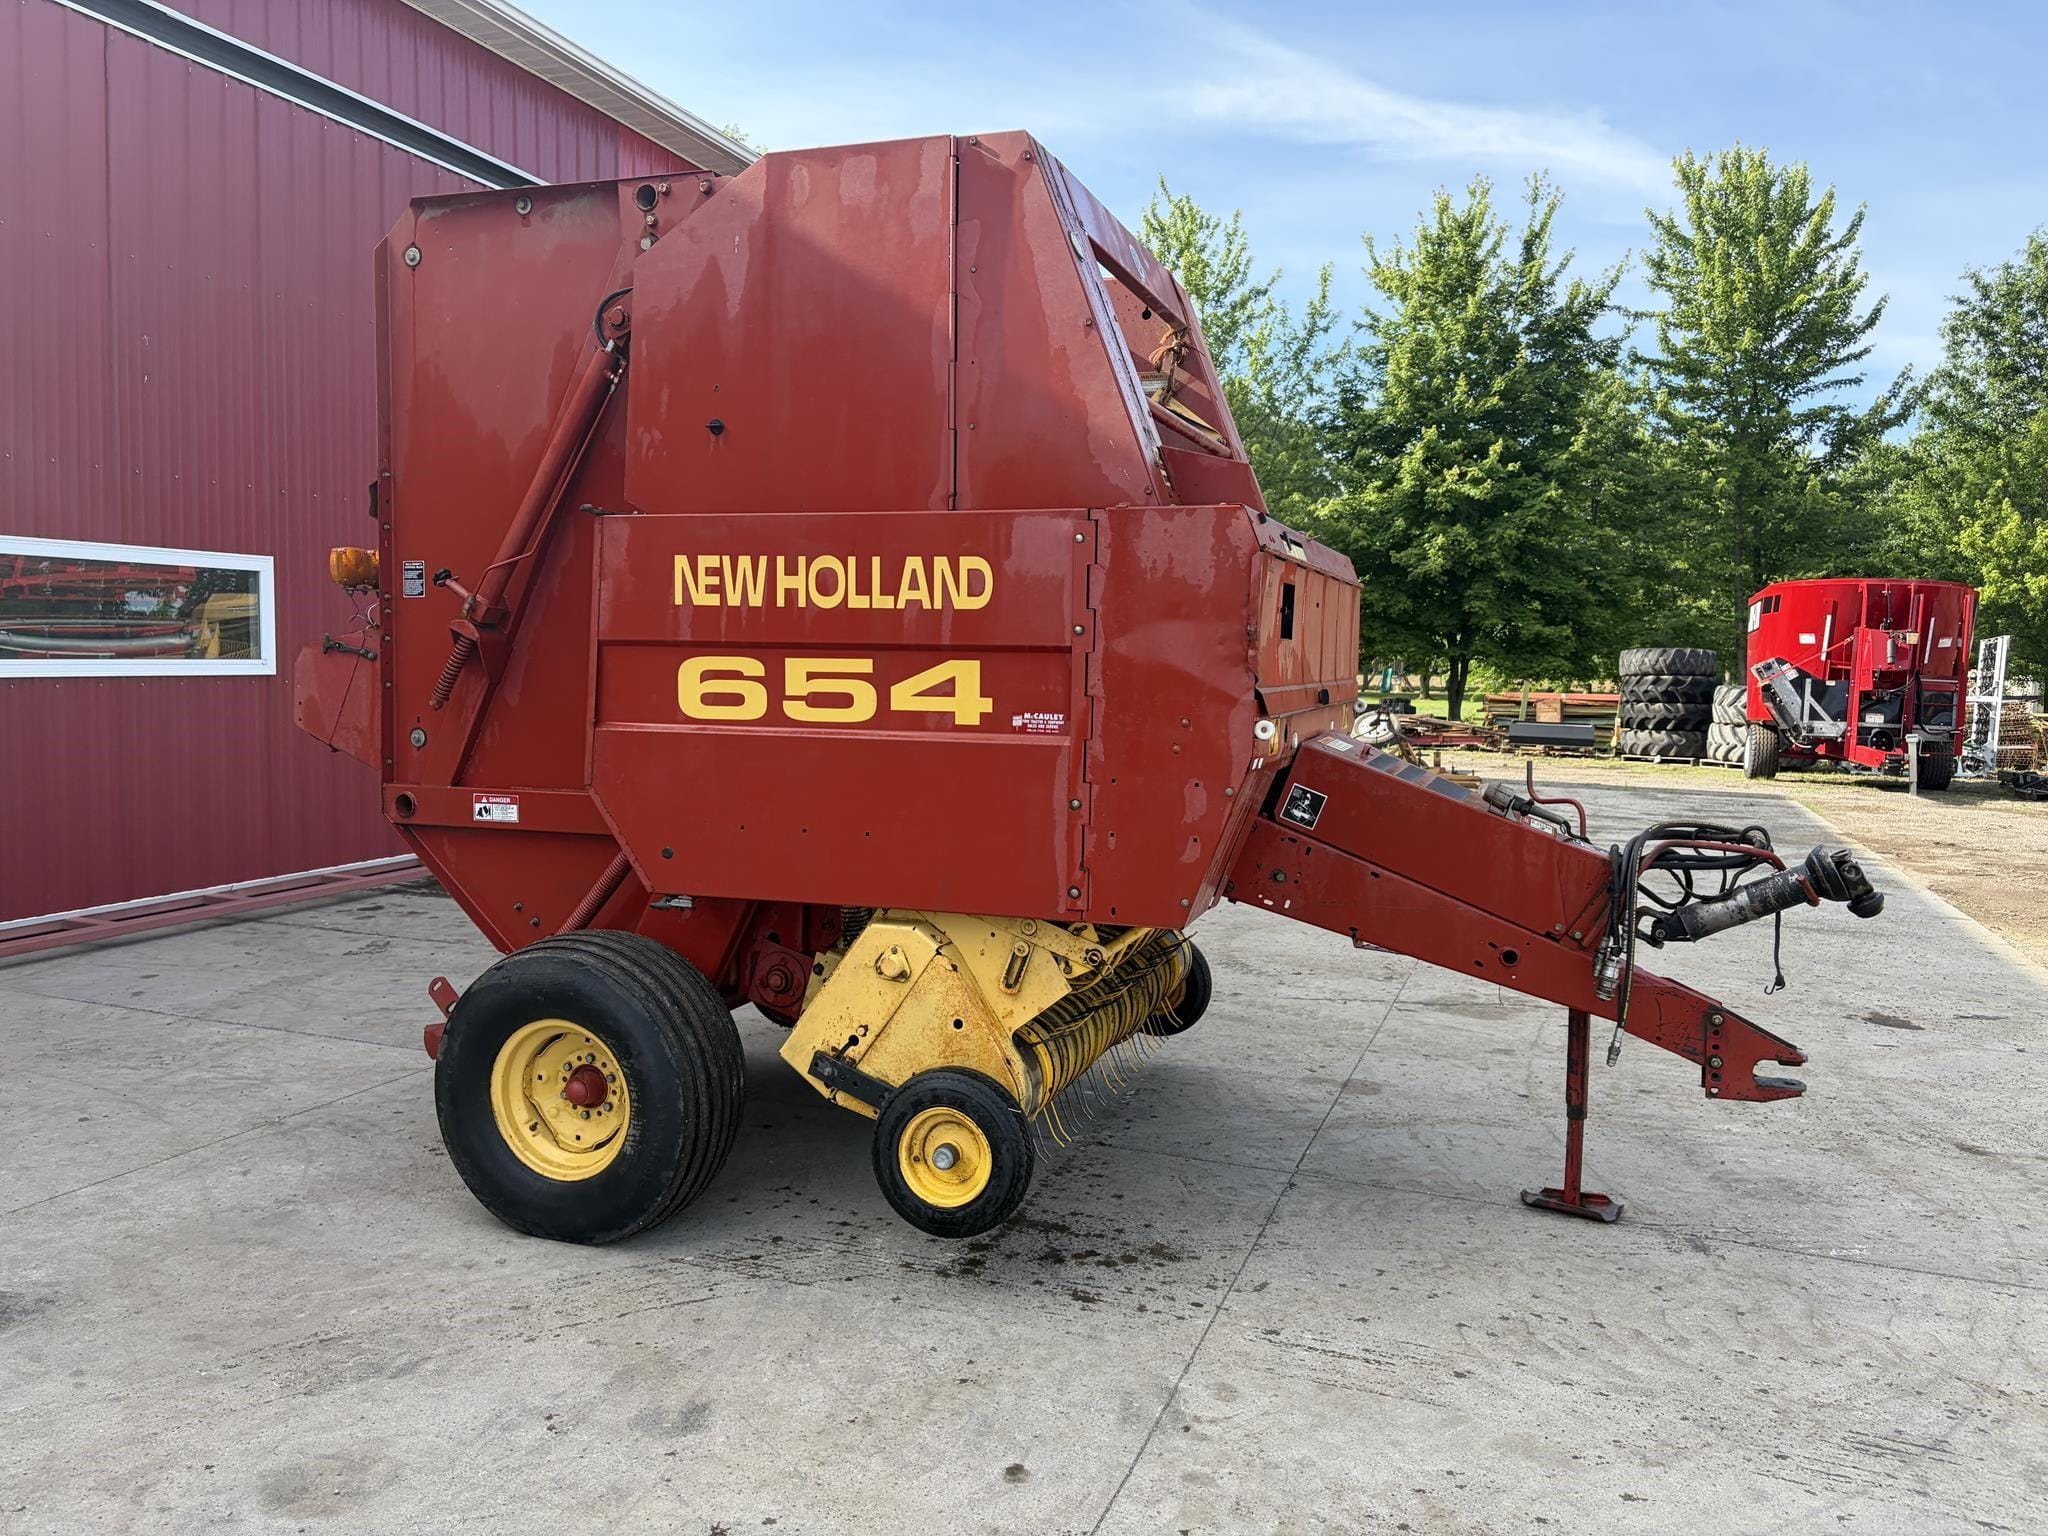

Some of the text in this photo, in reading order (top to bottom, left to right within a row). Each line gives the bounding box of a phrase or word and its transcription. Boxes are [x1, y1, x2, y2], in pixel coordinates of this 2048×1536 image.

[675, 555, 993, 610] NEW HOLLAND
[677, 655, 993, 726] 654
